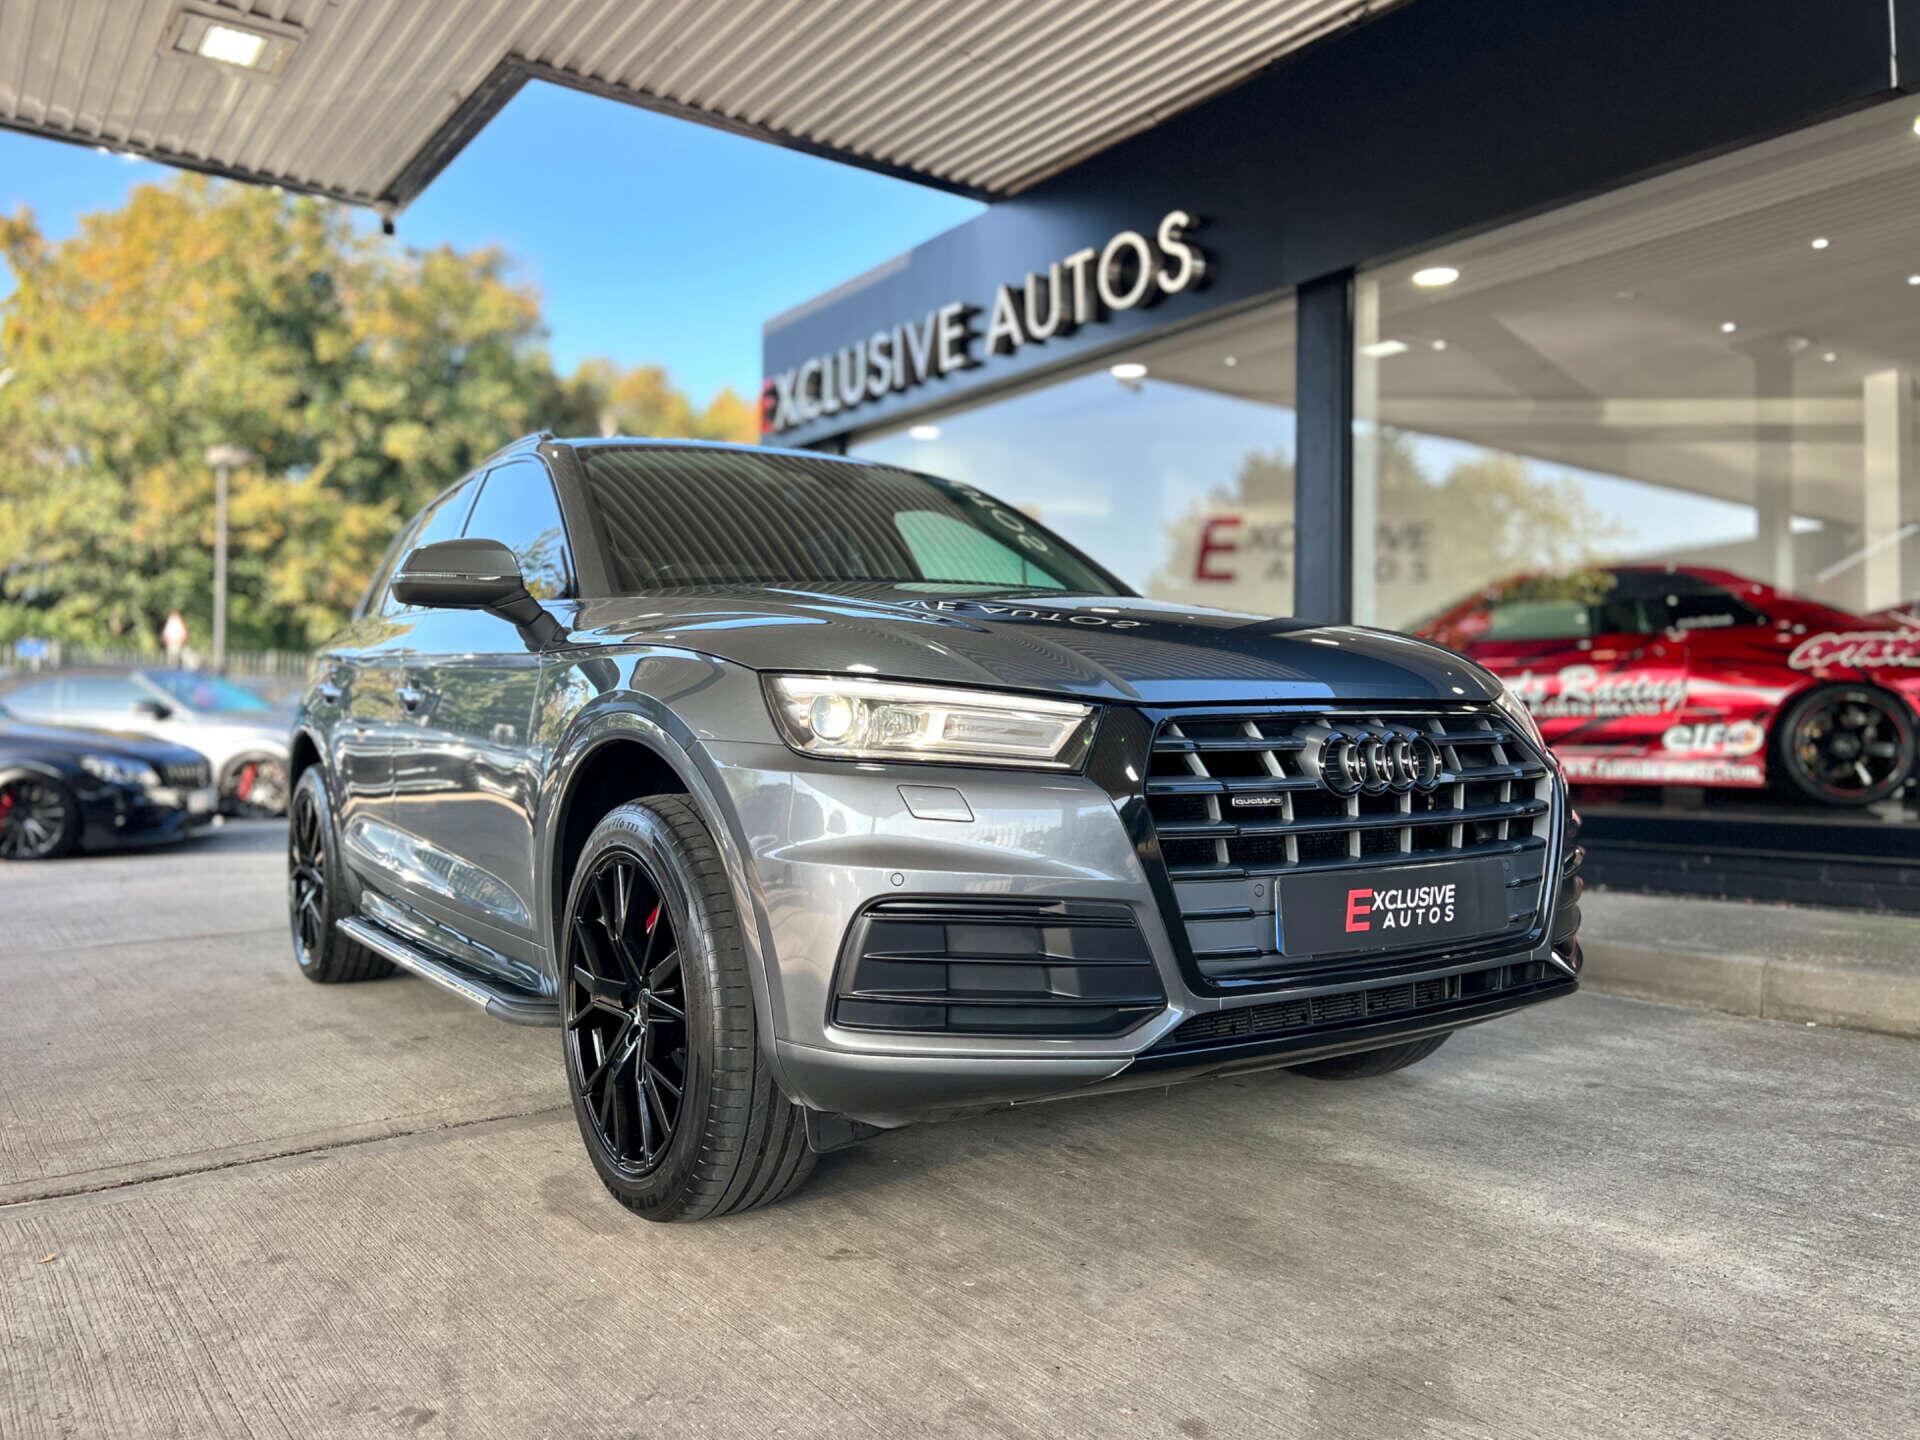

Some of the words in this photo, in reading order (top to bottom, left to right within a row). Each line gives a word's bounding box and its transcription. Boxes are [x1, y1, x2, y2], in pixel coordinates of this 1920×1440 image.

[760, 302, 968, 434] EXCLUSIVE
[985, 210, 1192, 357] AUTOS
[1234, 797, 1282, 805] quattro
[1346, 884, 1456, 932] EXCLUSIVE
[1382, 904, 1455, 929] AUTOS
